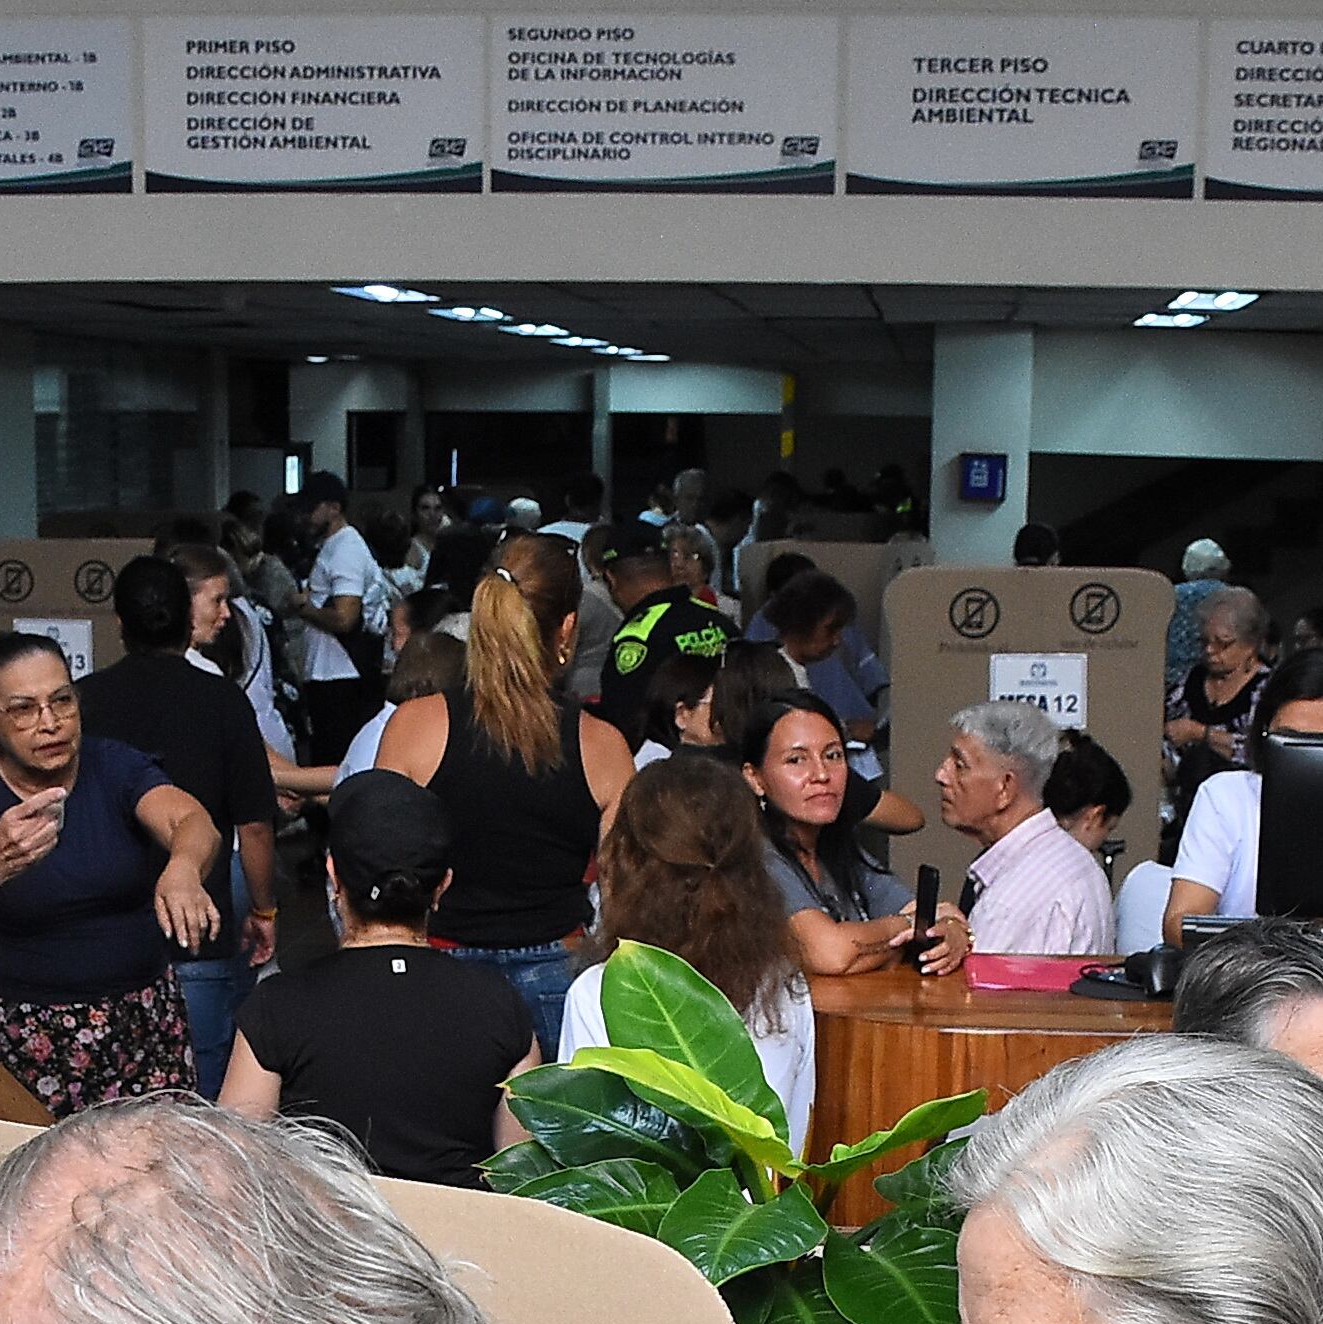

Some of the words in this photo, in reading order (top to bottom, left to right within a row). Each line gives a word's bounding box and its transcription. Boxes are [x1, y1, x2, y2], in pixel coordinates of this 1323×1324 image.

[508, 28, 591, 41] SEGUNDO
[597, 28, 634, 41] PISO
[187, 40, 249, 54] PRIMER
[255, 40, 295, 54] PISO
[1236, 41, 1314, 55] CUARTO
[508, 52, 578, 64] OFICINA
[583, 52, 604, 64] DE
[612, 51, 735, 67] TECNOLOGÍAS
[913, 58, 993, 73] TERCER
[1001, 58, 1048, 73] PISO
[187, 65, 286, 80] DIRECCIÓN
[290, 66, 441, 79] ADMINISTRATIVA
[508, 68, 528, 81] DE
[535, 68, 555, 81] LA
[561, 66, 681, 81] INFORMACIÓN
[187, 91, 285, 106] DIRECCIÓN
[291, 92, 400, 105] FINANCIERA
[913, 84, 1031, 103] DIRECCIÓN
[508, 98, 601, 113] DIRECCIÓN
[606, 101, 626, 112] DE
[633, 99, 744, 113] PLANEACIÓN
[912, 108, 1033, 123] AMBIENTAL
[187, 116, 286, 131] DIRECCIÓN
[292, 117, 313, 131] DE
[187, 134, 265, 149] GESTIÓN
[271, 136, 370, 149] AMBIENTAL
[508, 132, 577, 145] OFICINA
[583, 132, 603, 145] DE
[609, 132, 693, 145] CONTROL
[697, 132, 774, 145] INTERNO
[508, 148, 630, 160] DISCIPLINARIO
[1054, 694, 1078, 713] 12
